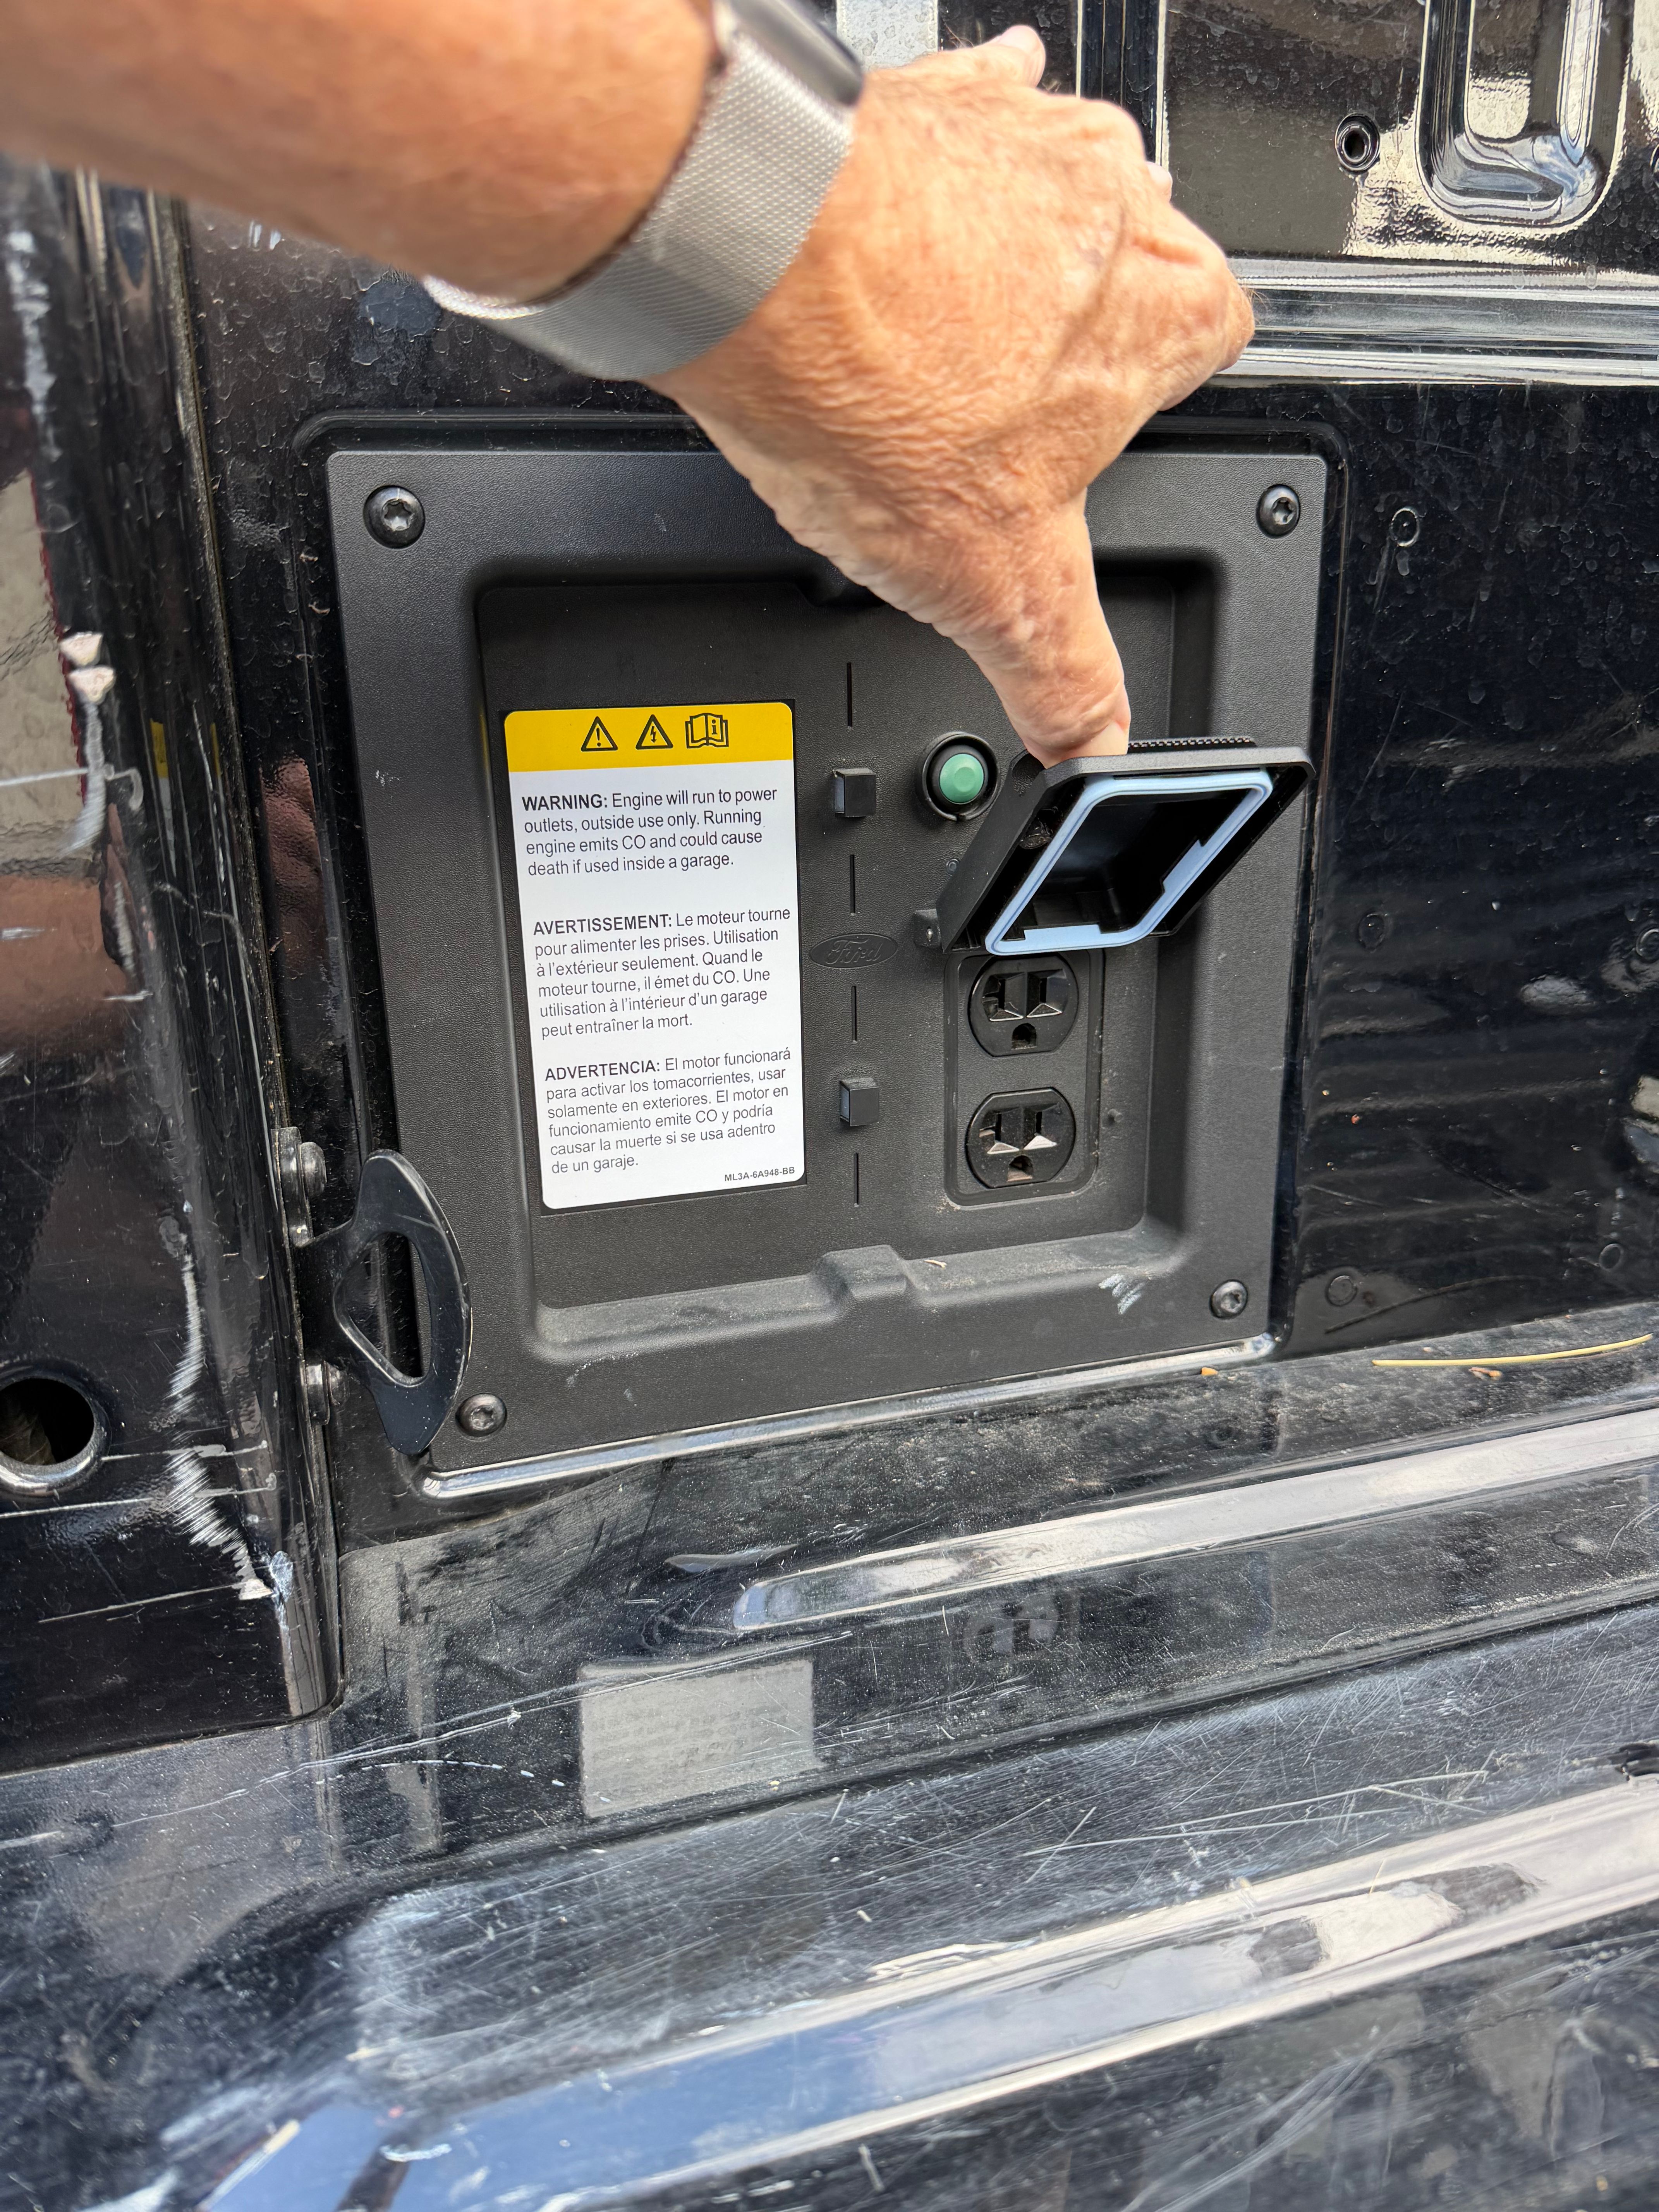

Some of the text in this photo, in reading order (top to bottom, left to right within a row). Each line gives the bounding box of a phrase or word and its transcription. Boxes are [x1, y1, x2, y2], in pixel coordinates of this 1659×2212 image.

[521, 789, 777, 811] WARNING: Engine will run to power
[524, 808, 761, 833] outlets, outside use only. Running
[526, 831, 763, 858] engine emits CO and could cause
[528, 854, 733, 876] death if used inside a garage.
[533, 909, 790, 936] AVERTISSEMENT: Le moteur tourne
[535, 927, 778, 960] pour alimenter les prises. Utilisation
[825, 938, 883, 965] Ford
[537, 948, 763, 977] à l'extérieur seulement. Quand le
[538, 968, 770, 997] moteur tourne, il émet du CO. Une
[540, 990, 767, 1017] utilisation à l'intérieur d'un garage
[542, 1013, 692, 1041] peut entraîner la mort.
[545, 1047, 791, 1081] ADVERTENCIA: El motor funcionará
[546, 1068, 786, 1103] para activar los tomacorrientes, usar
[548, 1087, 788, 1119] solamente en exteriores. El motor en
[548, 1103, 773, 1137] funcionamiento emite CO y podría
[550, 1123, 775, 1156] causar la muerte si se usa adentro
[551, 1154, 638, 1174] de un garaje.
[725, 1166, 795, 1182] ML3A-6A948-BB
